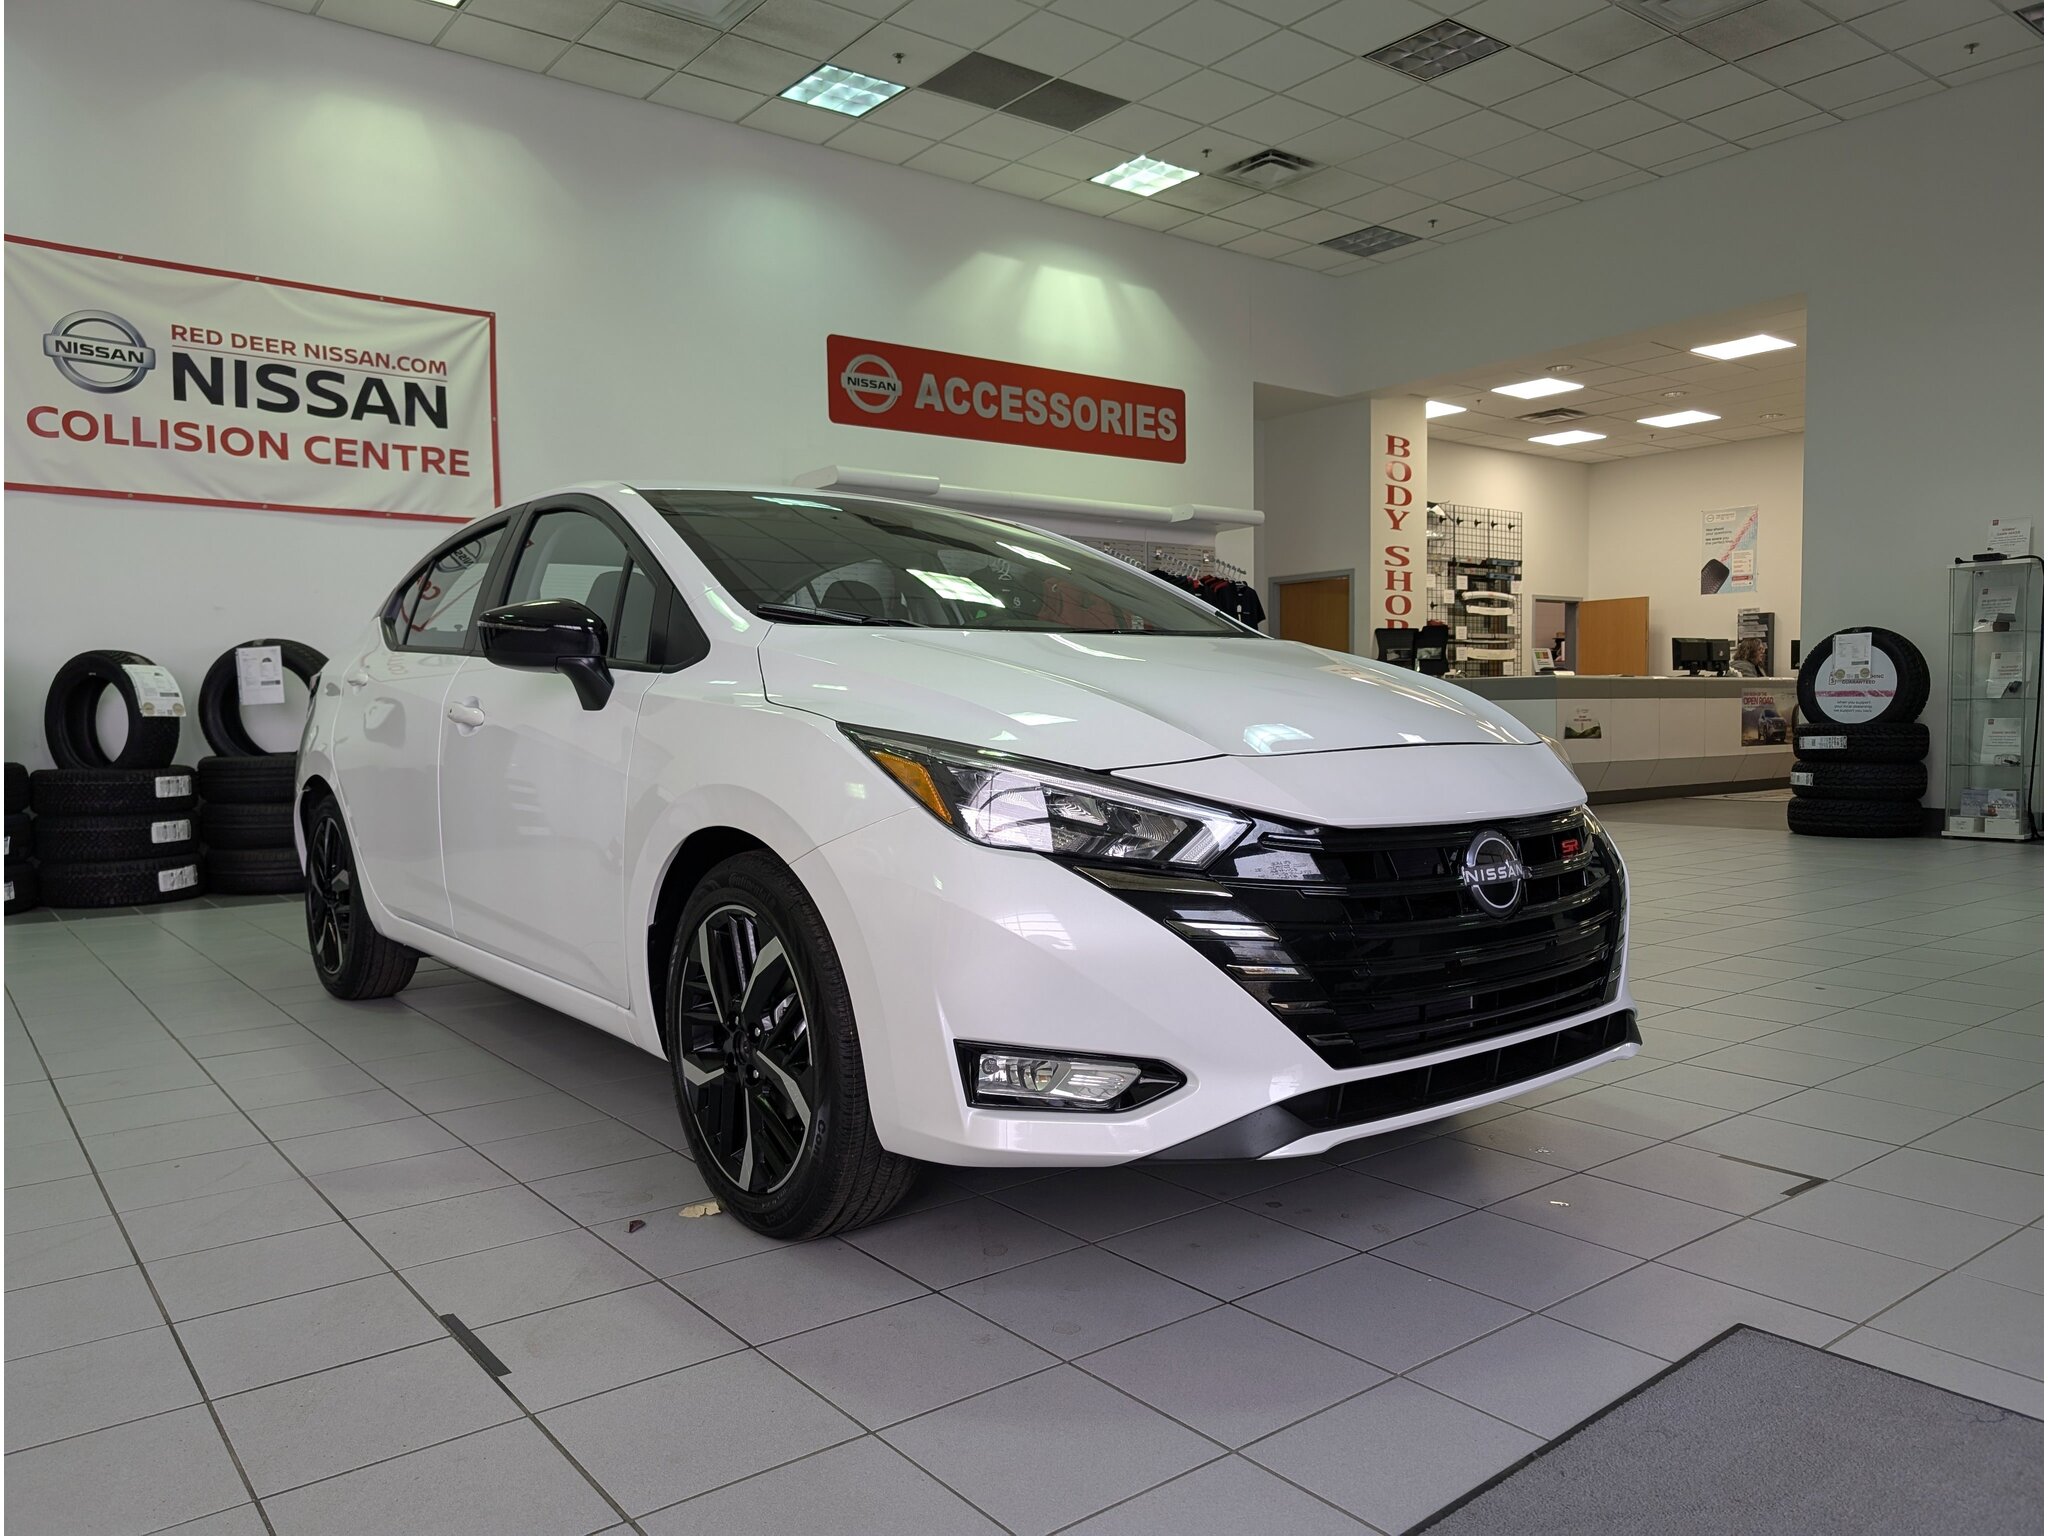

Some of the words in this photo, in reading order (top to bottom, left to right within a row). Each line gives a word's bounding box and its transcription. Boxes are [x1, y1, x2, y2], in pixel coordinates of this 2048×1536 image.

[54, 339, 145, 364] NISSAN
[170, 324, 223, 346] RED
[230, 333, 296, 356] DEER
[304, 343, 447, 376] NISSAN.COM
[172, 352, 449, 429] NISSAN
[847, 376, 897, 392] NISSAN
[914, 373, 1177, 442] ACCESSORIES
[26, 405, 289, 461] COLLISION
[304, 436, 471, 477] CENTRE
[1384, 434, 1413, 531] BODY
[1744, 696, 1759, 705] OPEN
[1760, 696, 1774, 705] ROAD
[1562, 839, 1579, 853] SR
[1465, 864, 1523, 882] NISSAN
